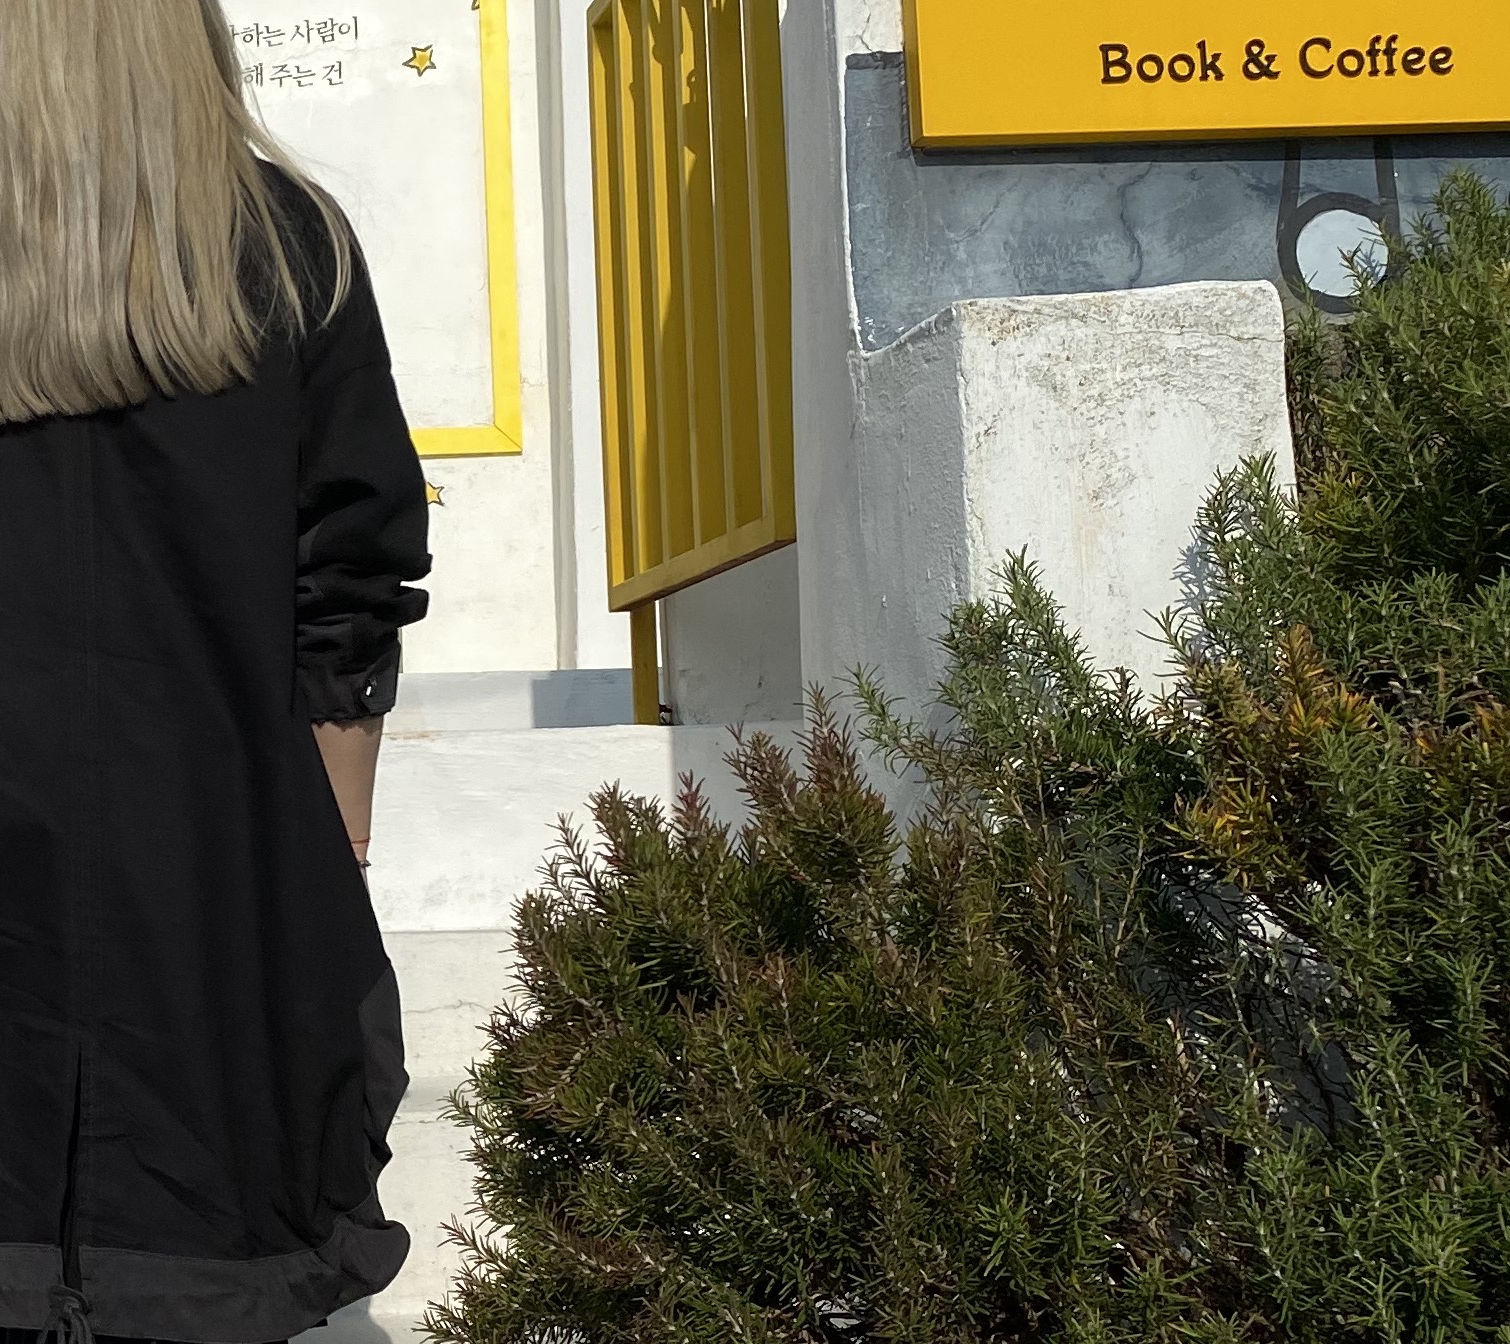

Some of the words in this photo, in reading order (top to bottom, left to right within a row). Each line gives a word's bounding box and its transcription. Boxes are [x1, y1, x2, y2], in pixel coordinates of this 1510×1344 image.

[290, 15, 359, 45] 사람이
[269, 63, 317, 88] 주는
[321, 60, 344, 87] 건
[1098, 40, 1225, 86] Book
[1241, 38, 1281, 83] &
[1298, 34, 1455, 81] Coffee
